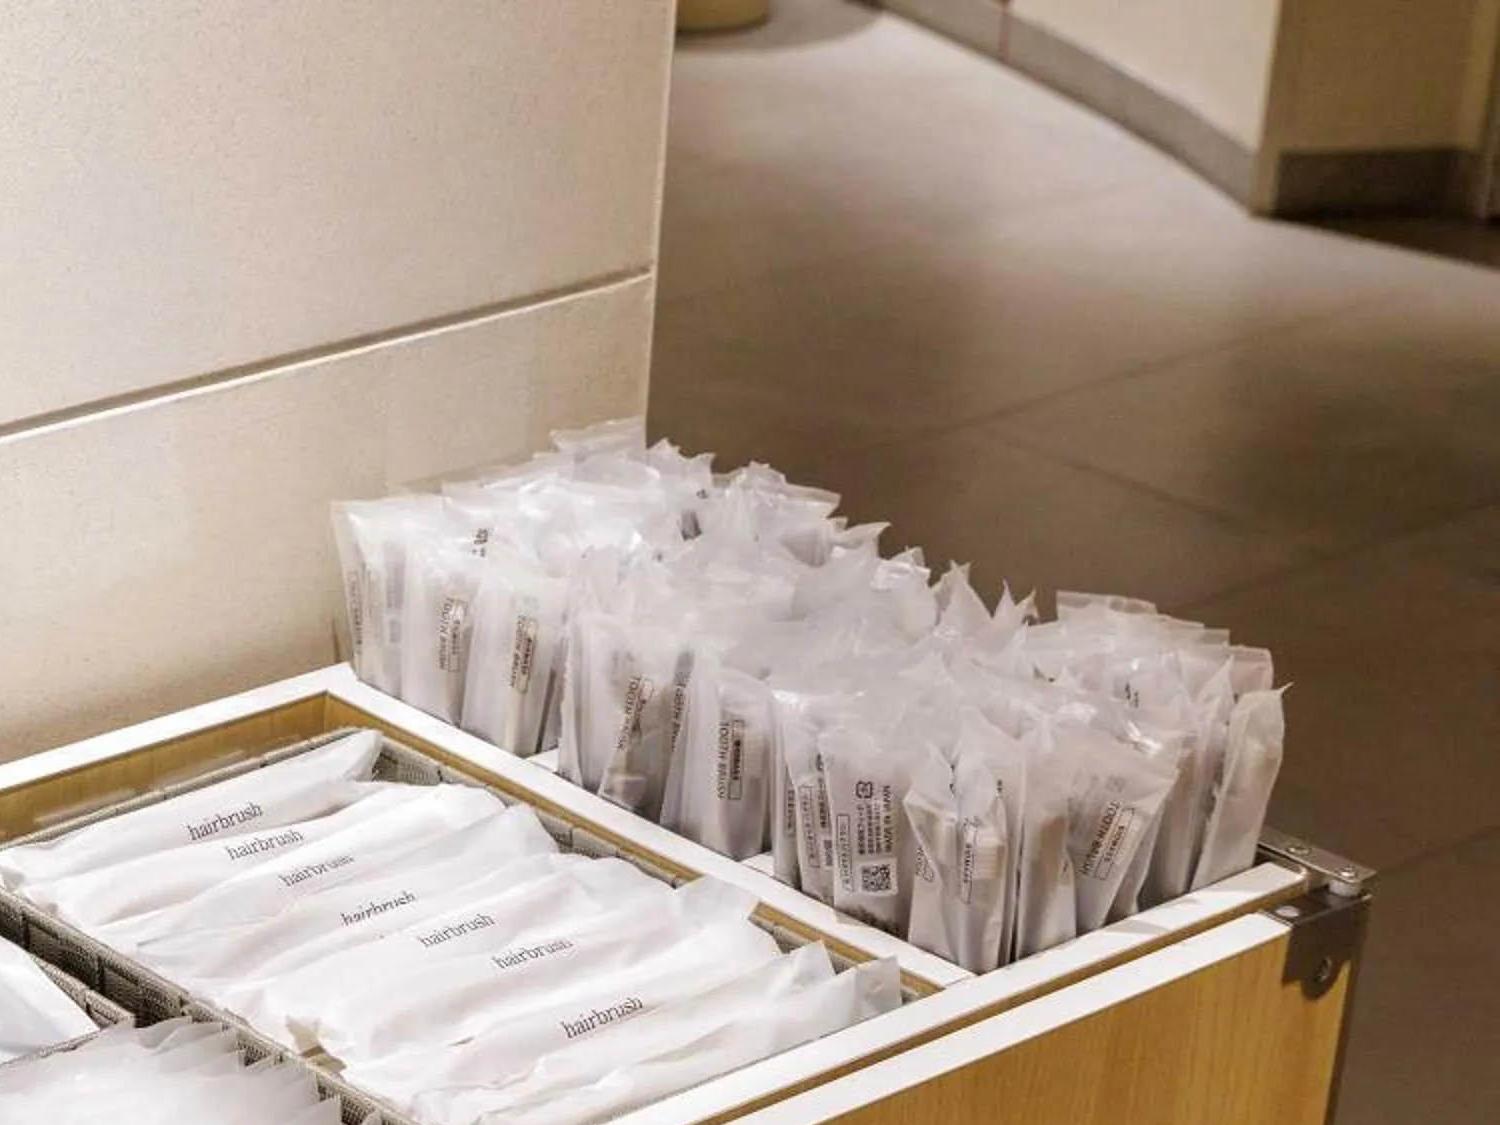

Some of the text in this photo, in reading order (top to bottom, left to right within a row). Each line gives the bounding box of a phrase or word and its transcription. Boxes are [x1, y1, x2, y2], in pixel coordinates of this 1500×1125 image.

[186, 801, 264, 841] hairbrush
[224, 827, 305, 862] hairbrush
[277, 852, 356, 888] hairbrush
[339, 888, 418, 927] hairbrush
[416, 912, 496, 949] hairbrush
[490, 938, 575, 970] hairbrush
[559, 995, 645, 1039] hairbrush
